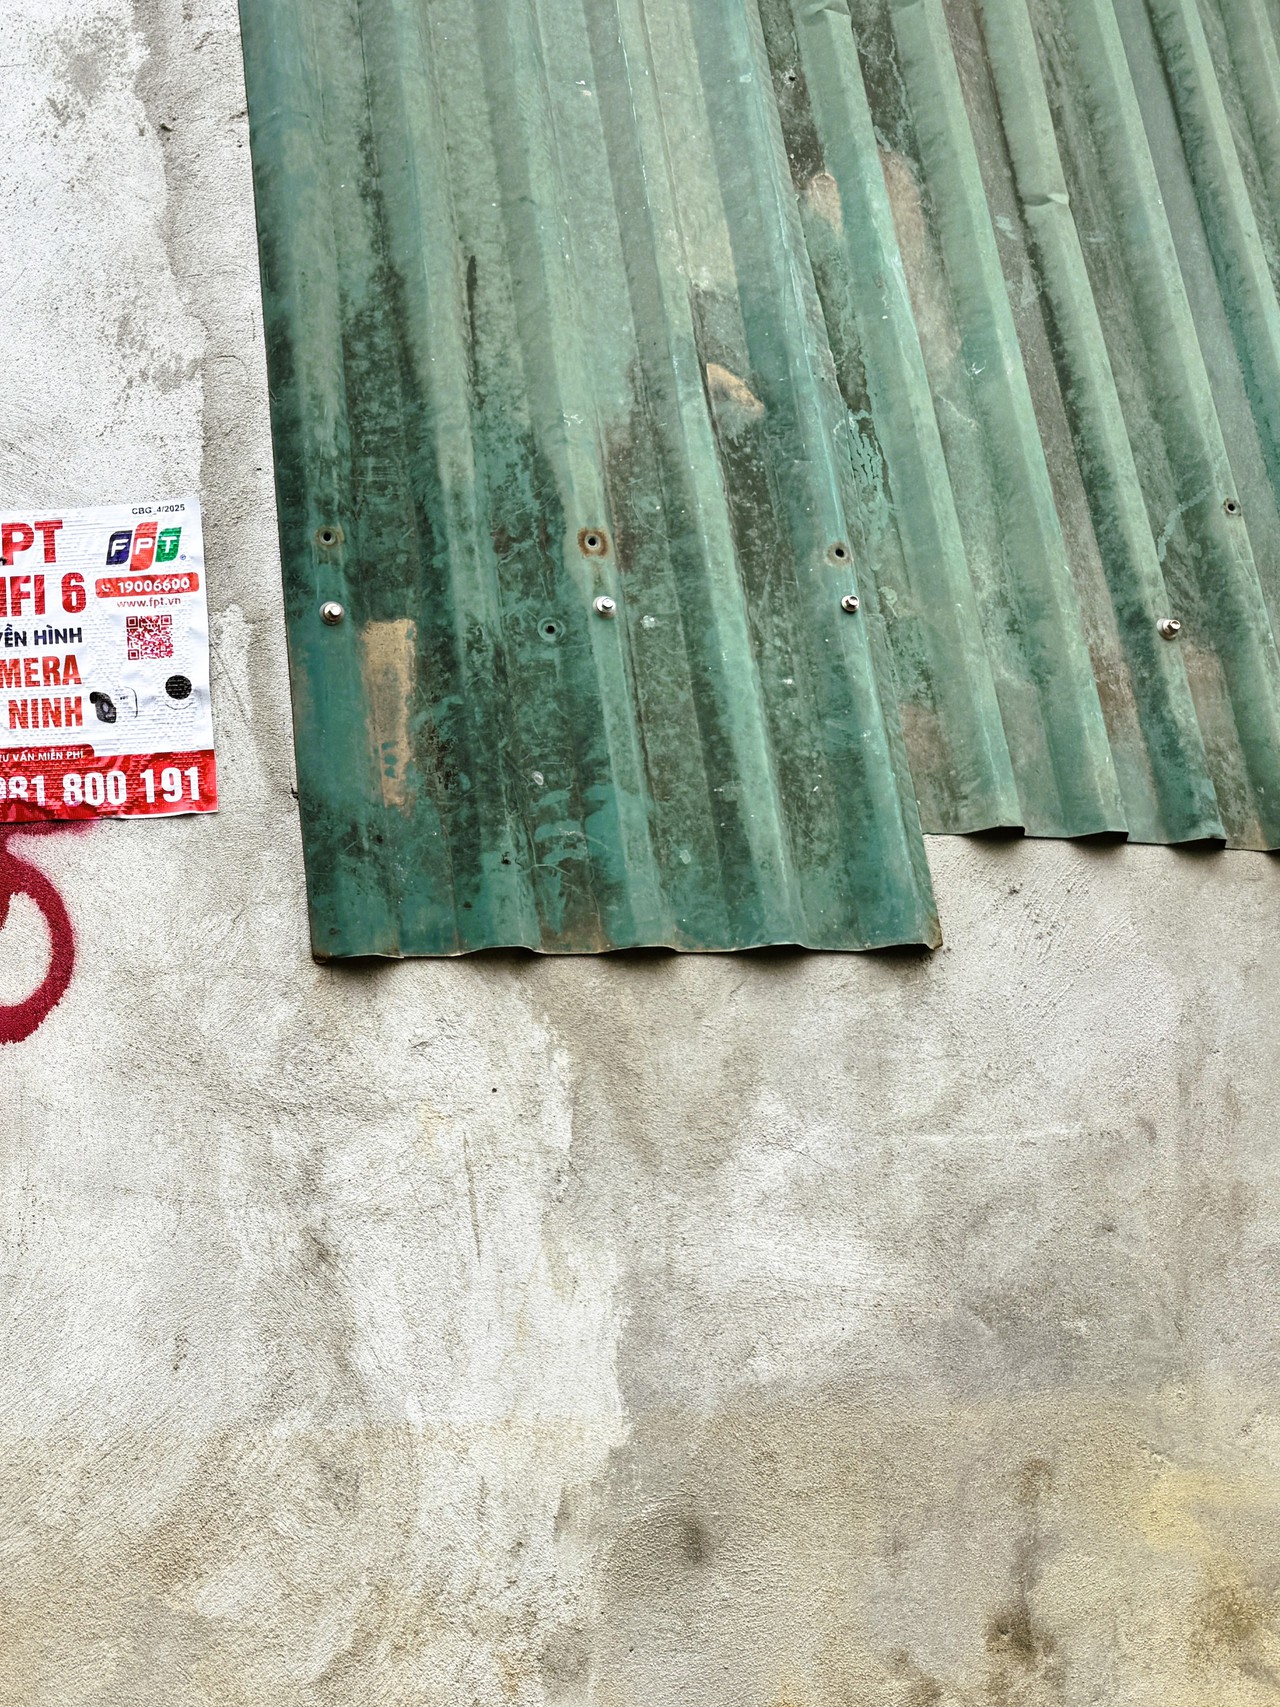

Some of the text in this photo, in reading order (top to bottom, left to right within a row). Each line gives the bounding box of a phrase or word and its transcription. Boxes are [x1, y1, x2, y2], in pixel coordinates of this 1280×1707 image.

[108, 529, 180, 564] FPT
[61, 572, 87, 613] 6
[117, 577, 191, 594] 19006600
[117, 597, 181, 609] www.fpt.vn
[33, 624, 83, 646] HÌNH
[9, 696, 84, 730] NINH
[62, 770, 127, 807] 800
[140, 766, 200, 803] 191
